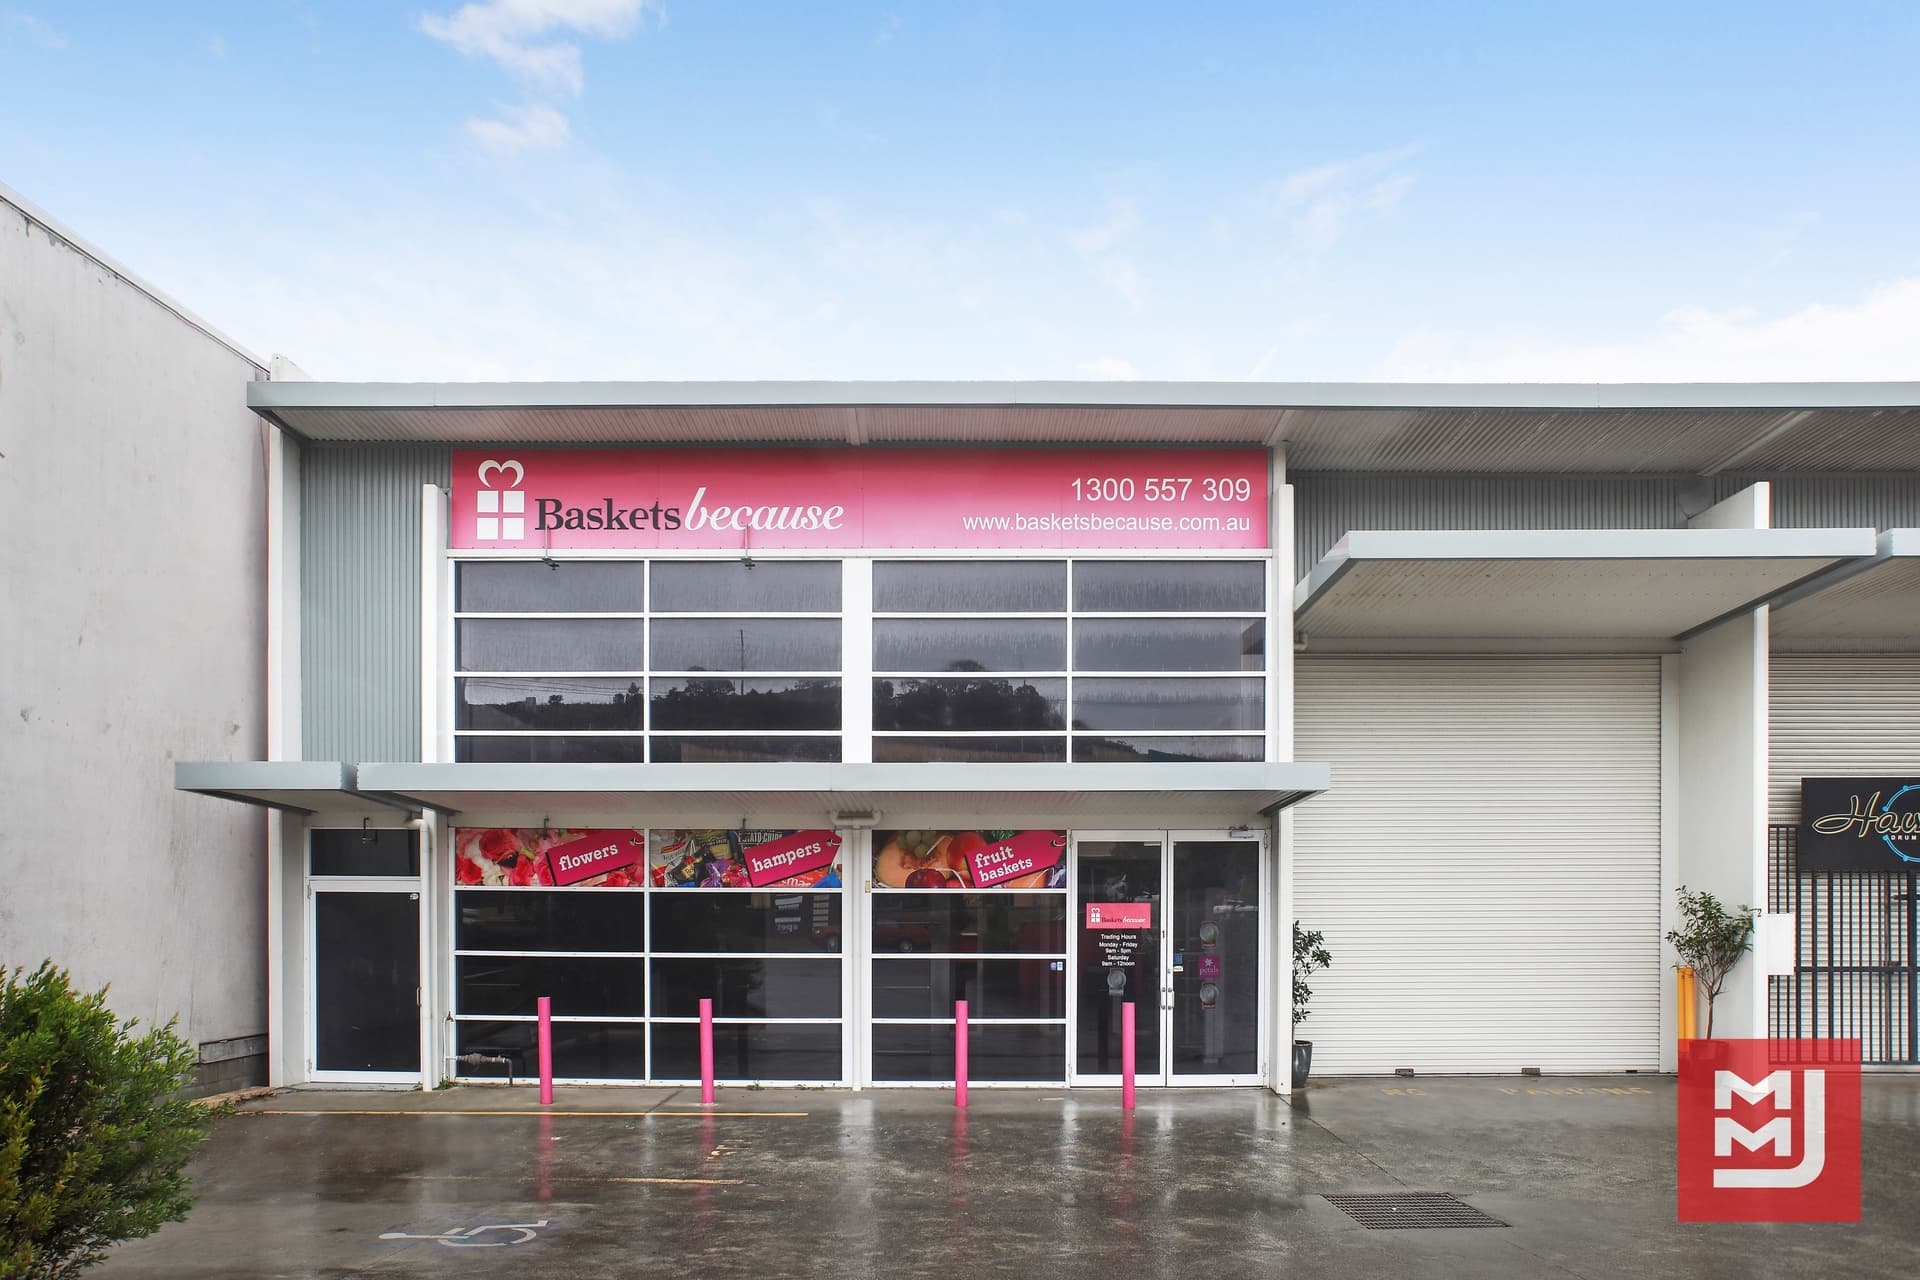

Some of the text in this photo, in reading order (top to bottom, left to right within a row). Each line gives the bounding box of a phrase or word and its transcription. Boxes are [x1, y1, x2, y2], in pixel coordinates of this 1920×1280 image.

[1071, 478, 1251, 502] 1300 557 309
[534, 487, 844, 532] Baskets because
[962, 513, 1251, 532] www.basketsbecause.com.au
[558, 844, 618, 872] flowers
[751, 841, 822, 873] hampers
[975, 846, 1015, 869] fruit
[979, 858, 1033, 882] baskets
[1101, 933, 1120, 941] Trading
